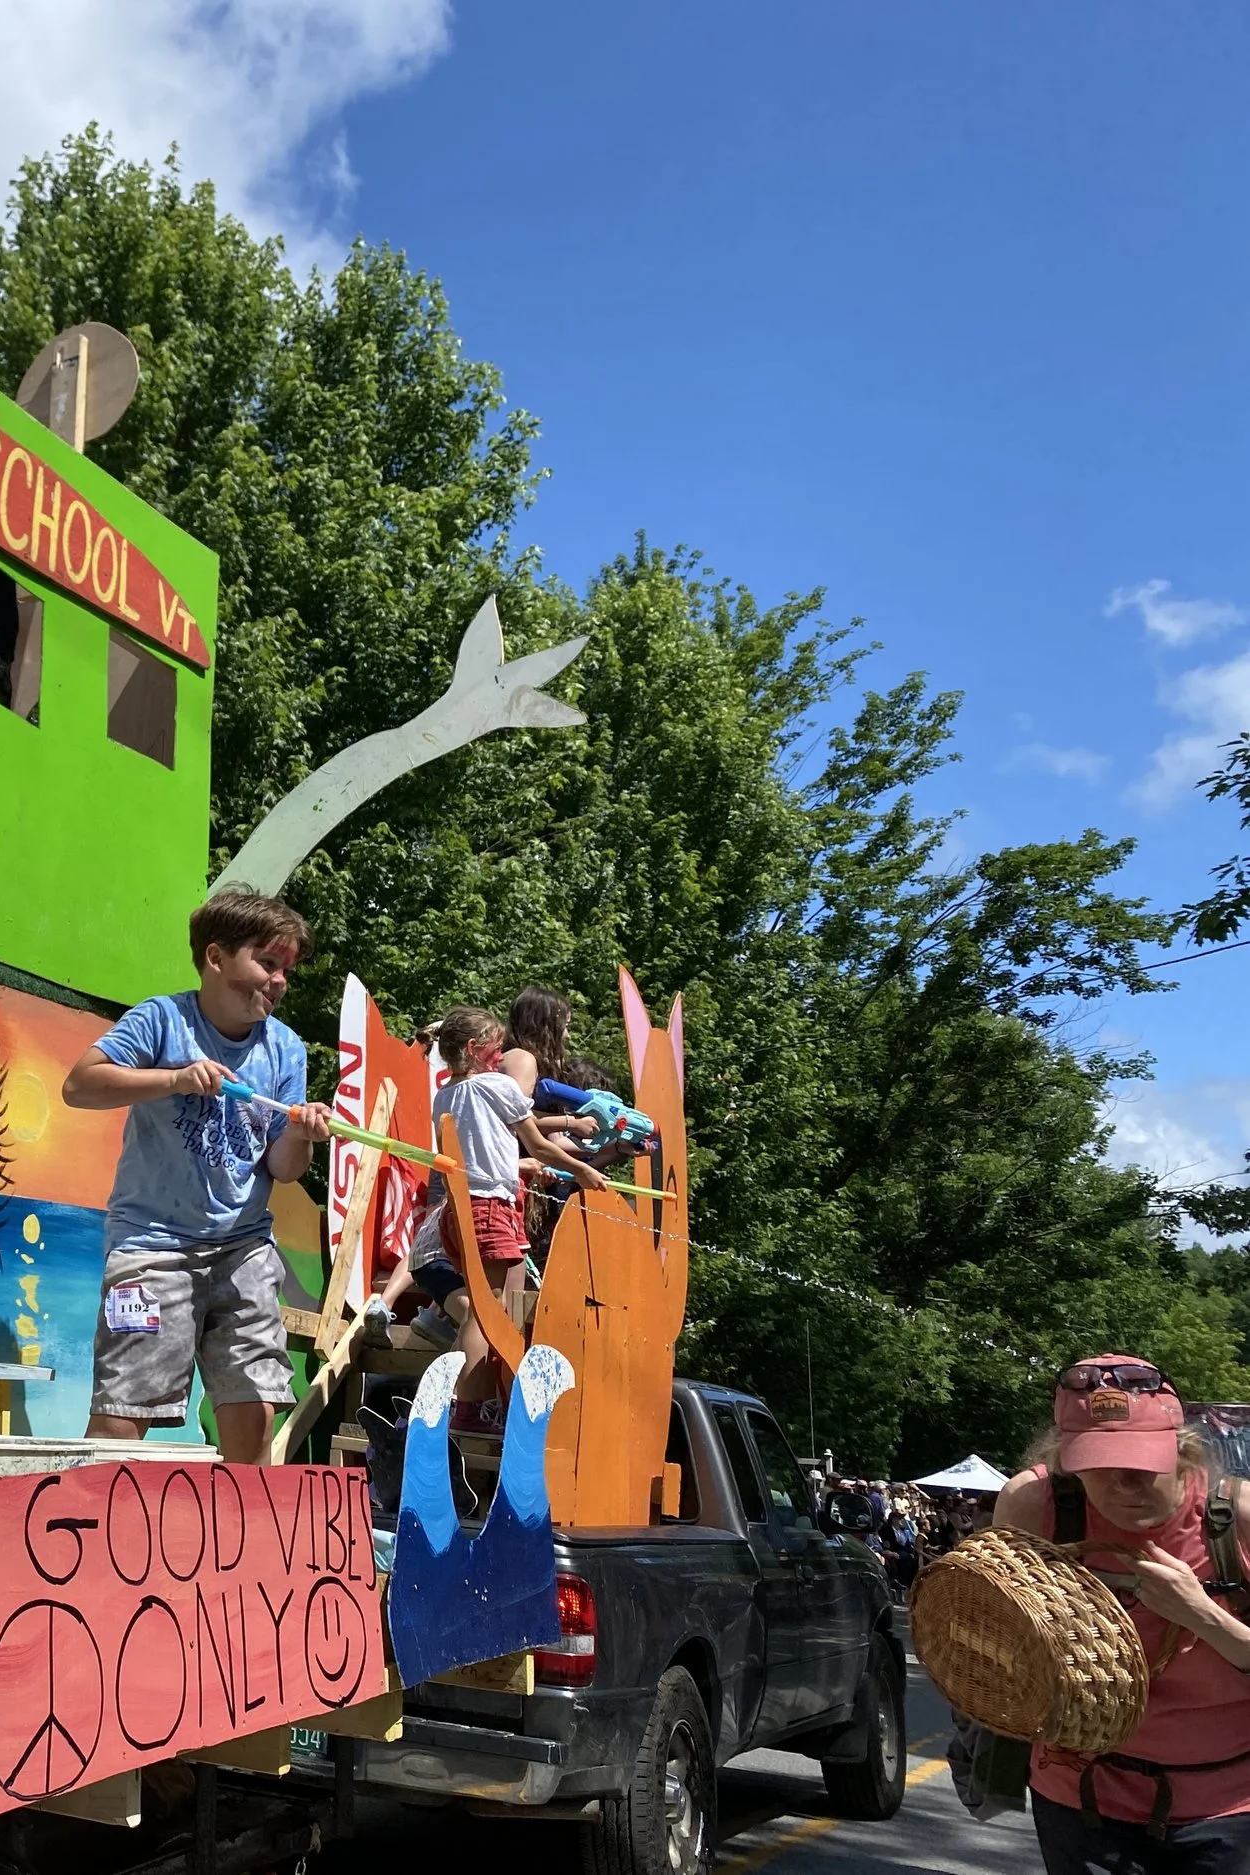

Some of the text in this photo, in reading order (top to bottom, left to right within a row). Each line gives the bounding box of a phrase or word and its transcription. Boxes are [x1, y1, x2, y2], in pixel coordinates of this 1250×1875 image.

[157, 577, 197, 652] VT
[120, 1303, 150, 1313] 1192
[24, 1464, 377, 1591] GOOD VIBES
[115, 1581, 295, 1751] ONLY
